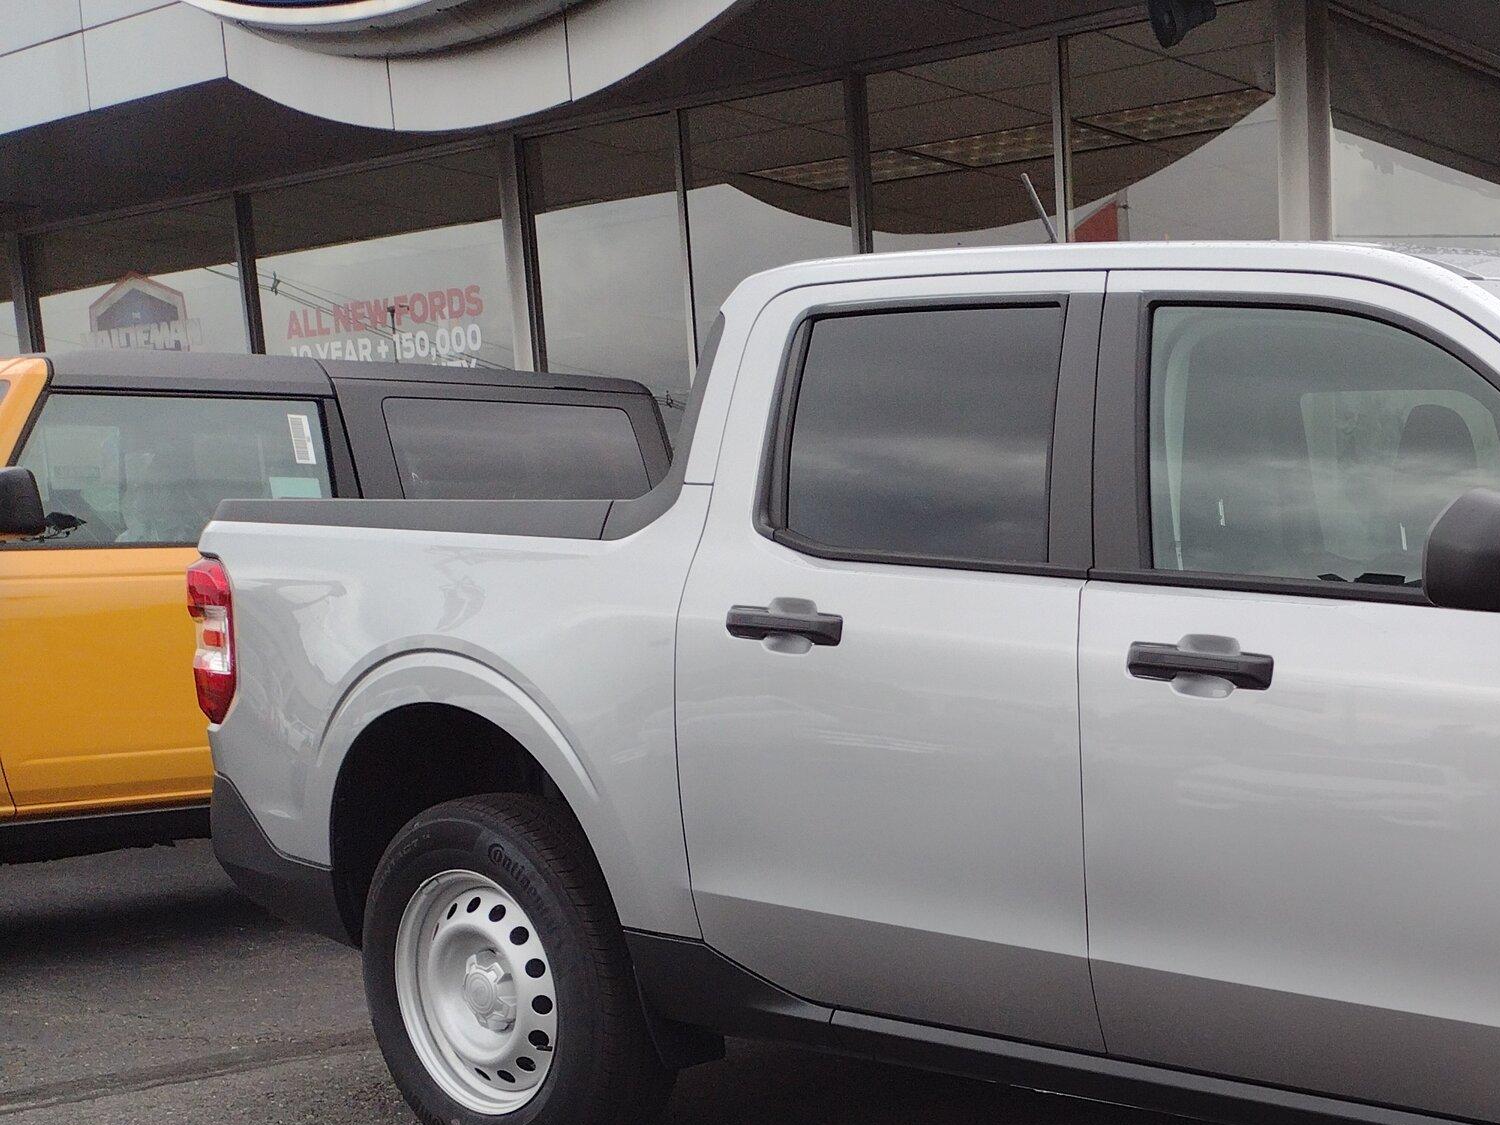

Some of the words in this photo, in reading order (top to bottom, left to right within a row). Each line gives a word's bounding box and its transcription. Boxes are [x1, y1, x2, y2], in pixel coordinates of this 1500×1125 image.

[287, 307, 330, 340] ALL
[332, 298, 389, 334] NEW
[393, 284, 484, 327] FORDS
[315, 338, 373, 362] YEAR
[392, 323, 482, 361] 150,000
